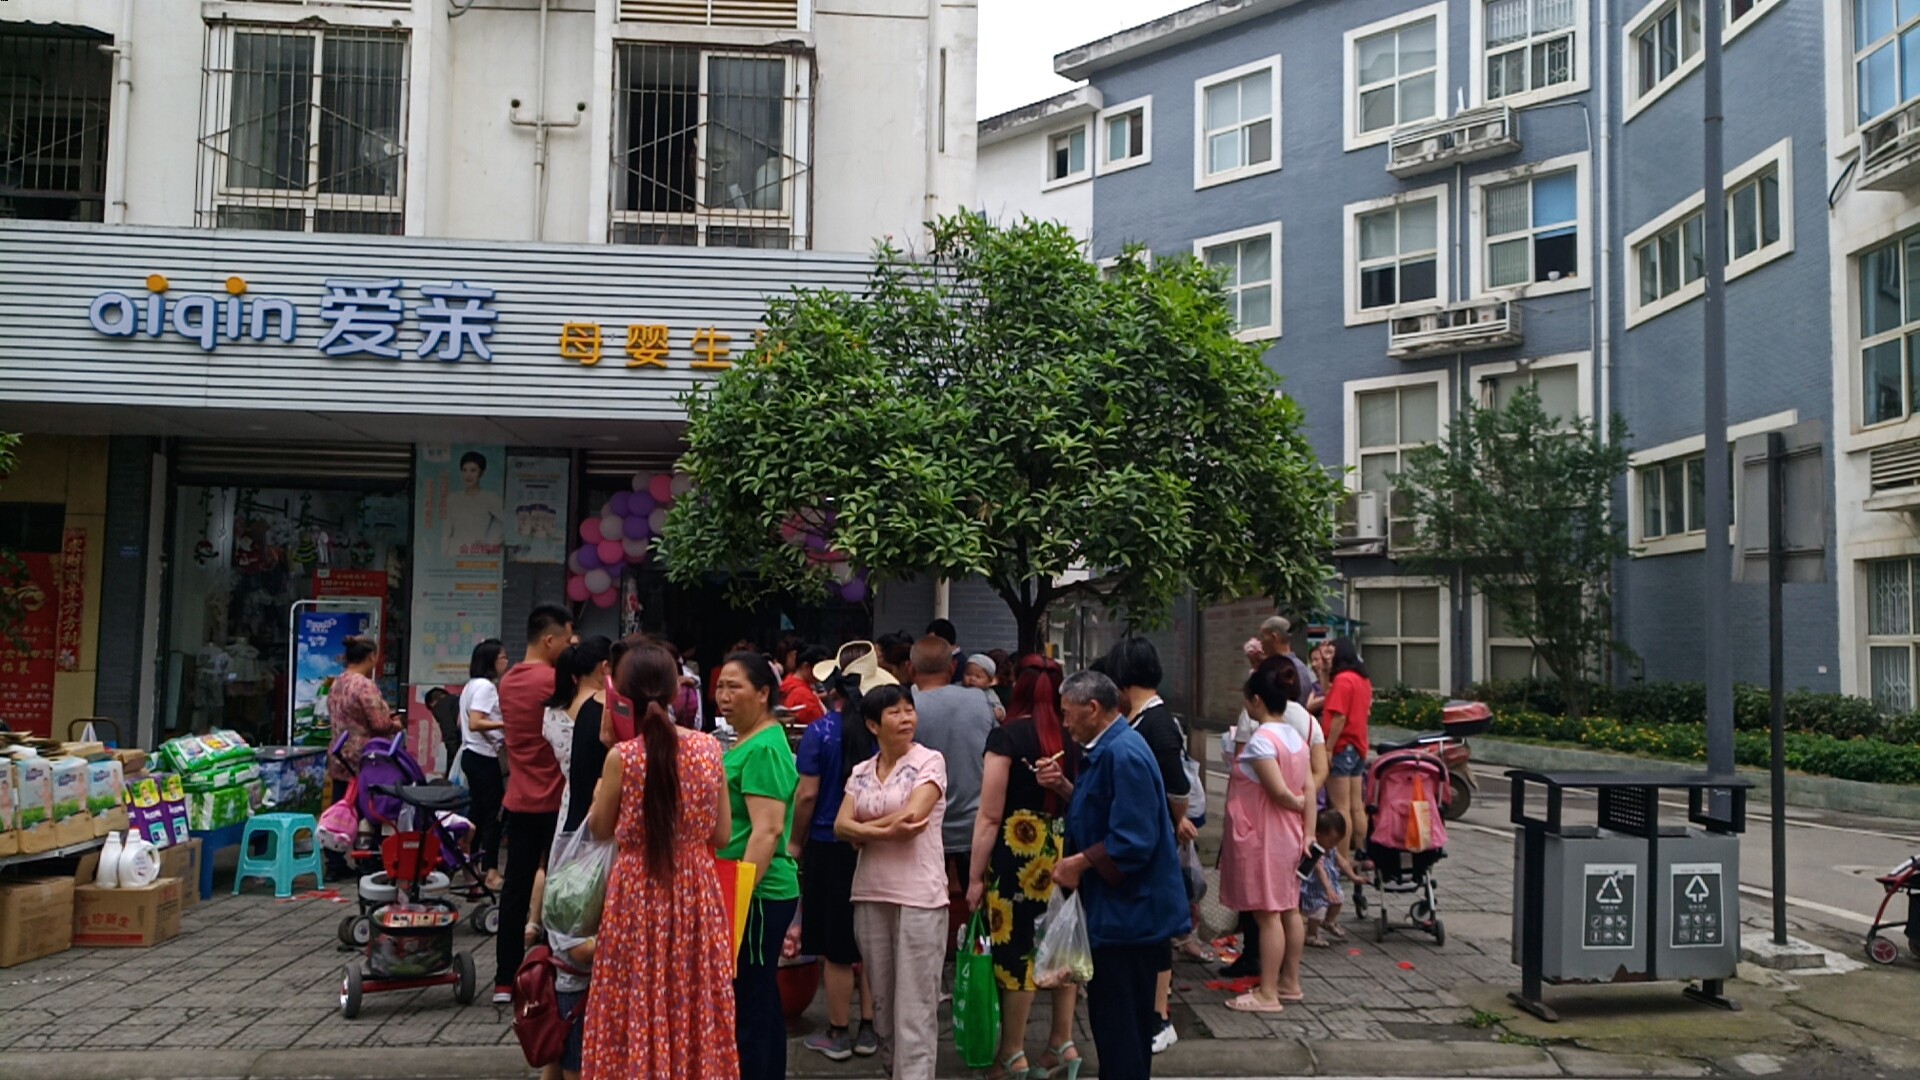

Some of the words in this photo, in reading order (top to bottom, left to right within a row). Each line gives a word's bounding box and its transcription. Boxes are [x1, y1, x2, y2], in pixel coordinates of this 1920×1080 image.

[89, 274, 297, 351] aiqin
[318, 279, 498, 361] 爱亲
[559, 322, 786, 369] 母婴生
